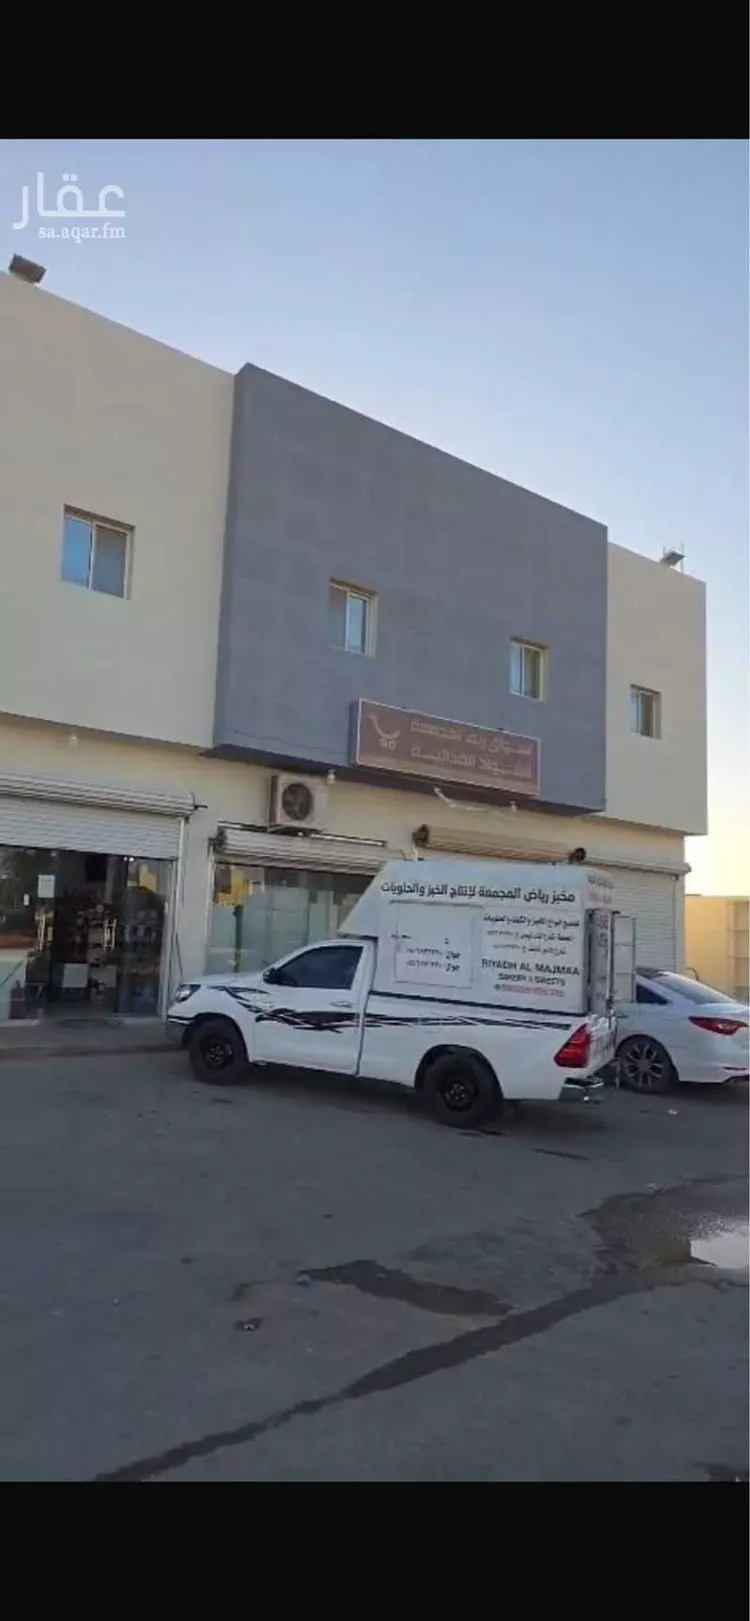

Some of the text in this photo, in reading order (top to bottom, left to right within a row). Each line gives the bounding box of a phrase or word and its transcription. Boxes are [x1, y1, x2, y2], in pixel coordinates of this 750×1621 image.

[380, 881, 425, 897] والحلويات
[427, 884, 449, 898] الخبز
[478, 885, 522, 901] المجمعة
[524, 887, 549, 903] رياض
[551, 889, 576, 904] مخبز
[481, 958, 581, 977] RIYADH AL MAJMAA
